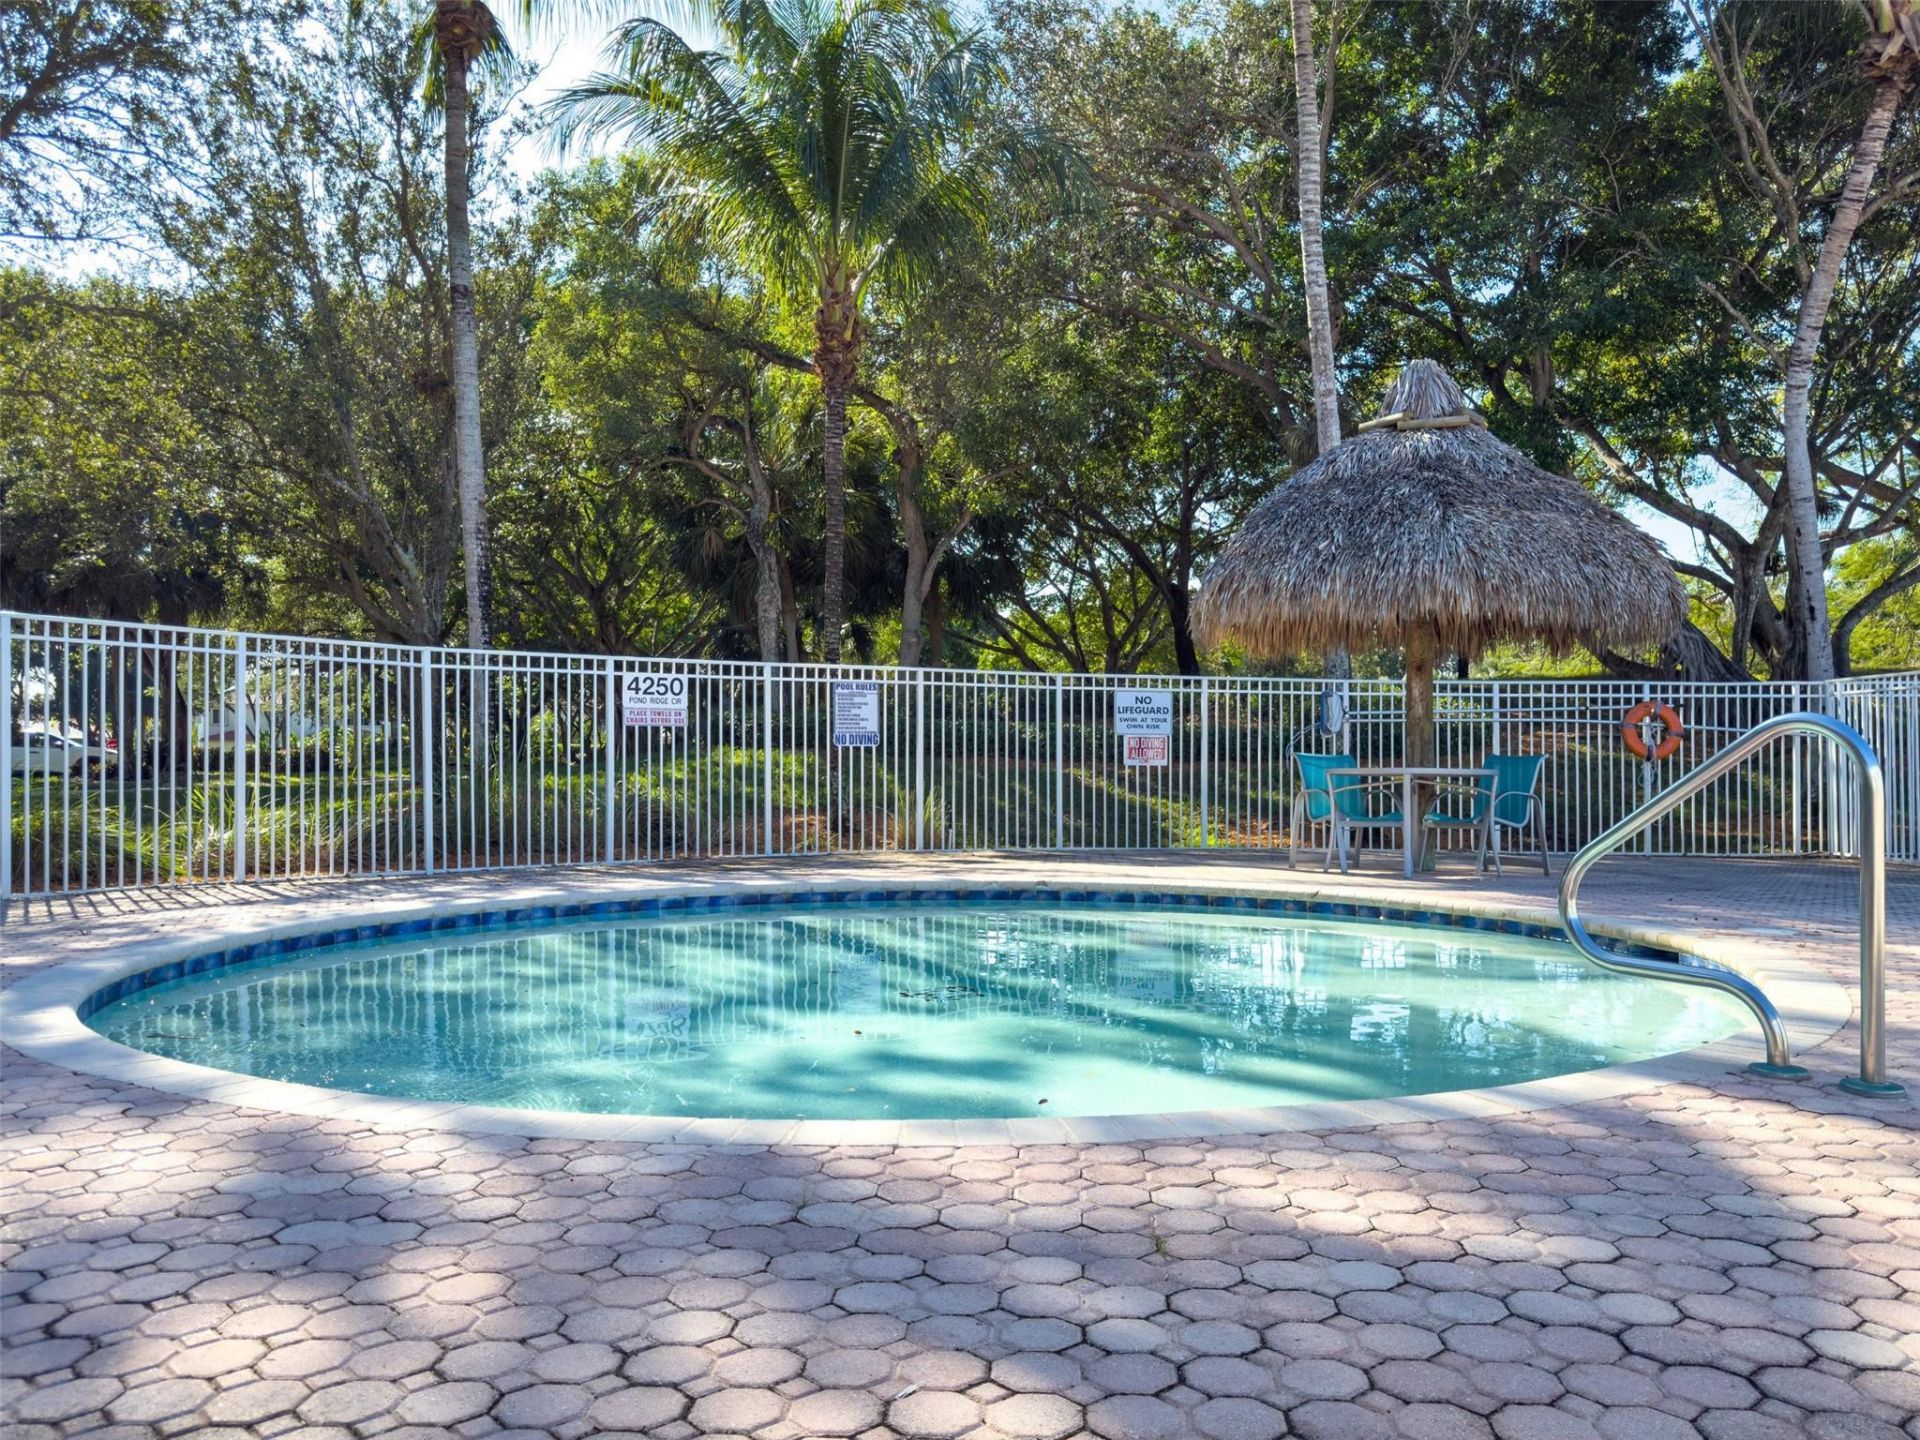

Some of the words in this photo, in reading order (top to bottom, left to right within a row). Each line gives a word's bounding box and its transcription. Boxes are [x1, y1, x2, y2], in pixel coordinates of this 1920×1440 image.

[627, 676, 684, 696] 4250
[855, 683, 877, 691] RULES
[1135, 696, 1152, 705] NO
[1117, 706, 1170, 715] LIFEGUARD
[835, 735, 847, 745] NO
[849, 735, 879, 745] DIVING
[1129, 737, 1140, 748] NO
[1129, 748, 1163, 759] ALLOWED
